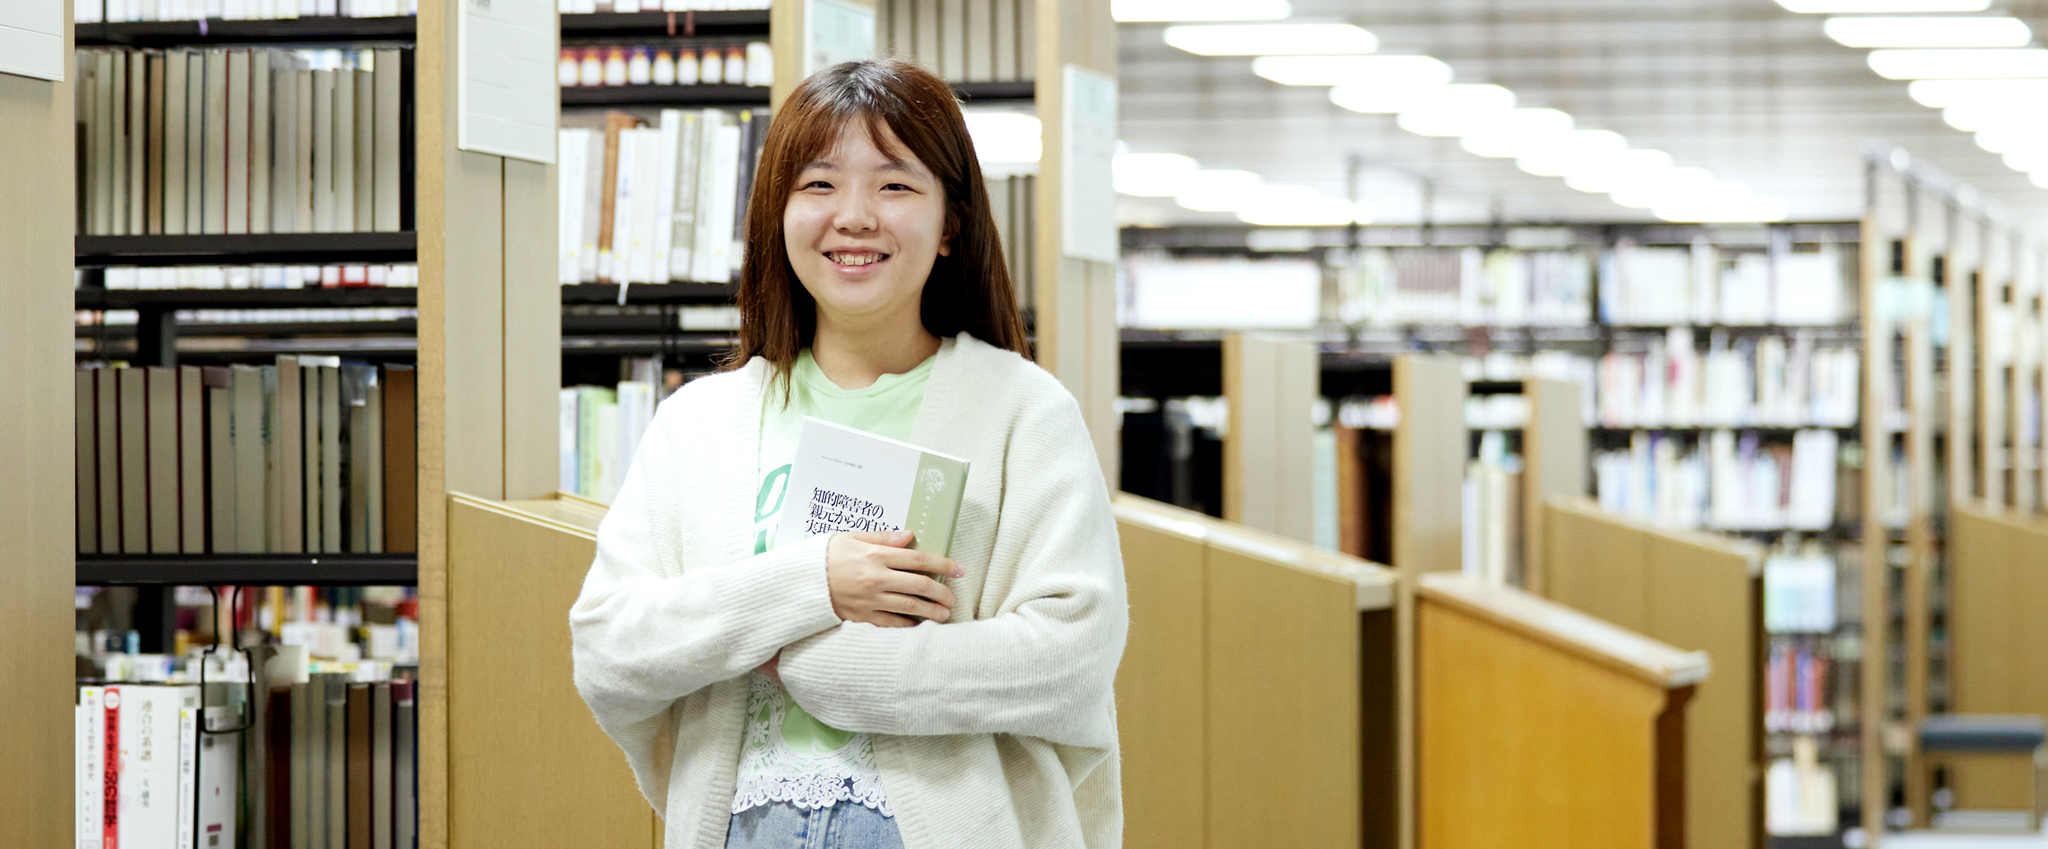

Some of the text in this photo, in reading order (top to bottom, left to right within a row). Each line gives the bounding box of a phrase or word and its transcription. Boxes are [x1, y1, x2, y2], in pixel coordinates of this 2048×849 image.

[811, 487, 884, 519] 知的障害者の
